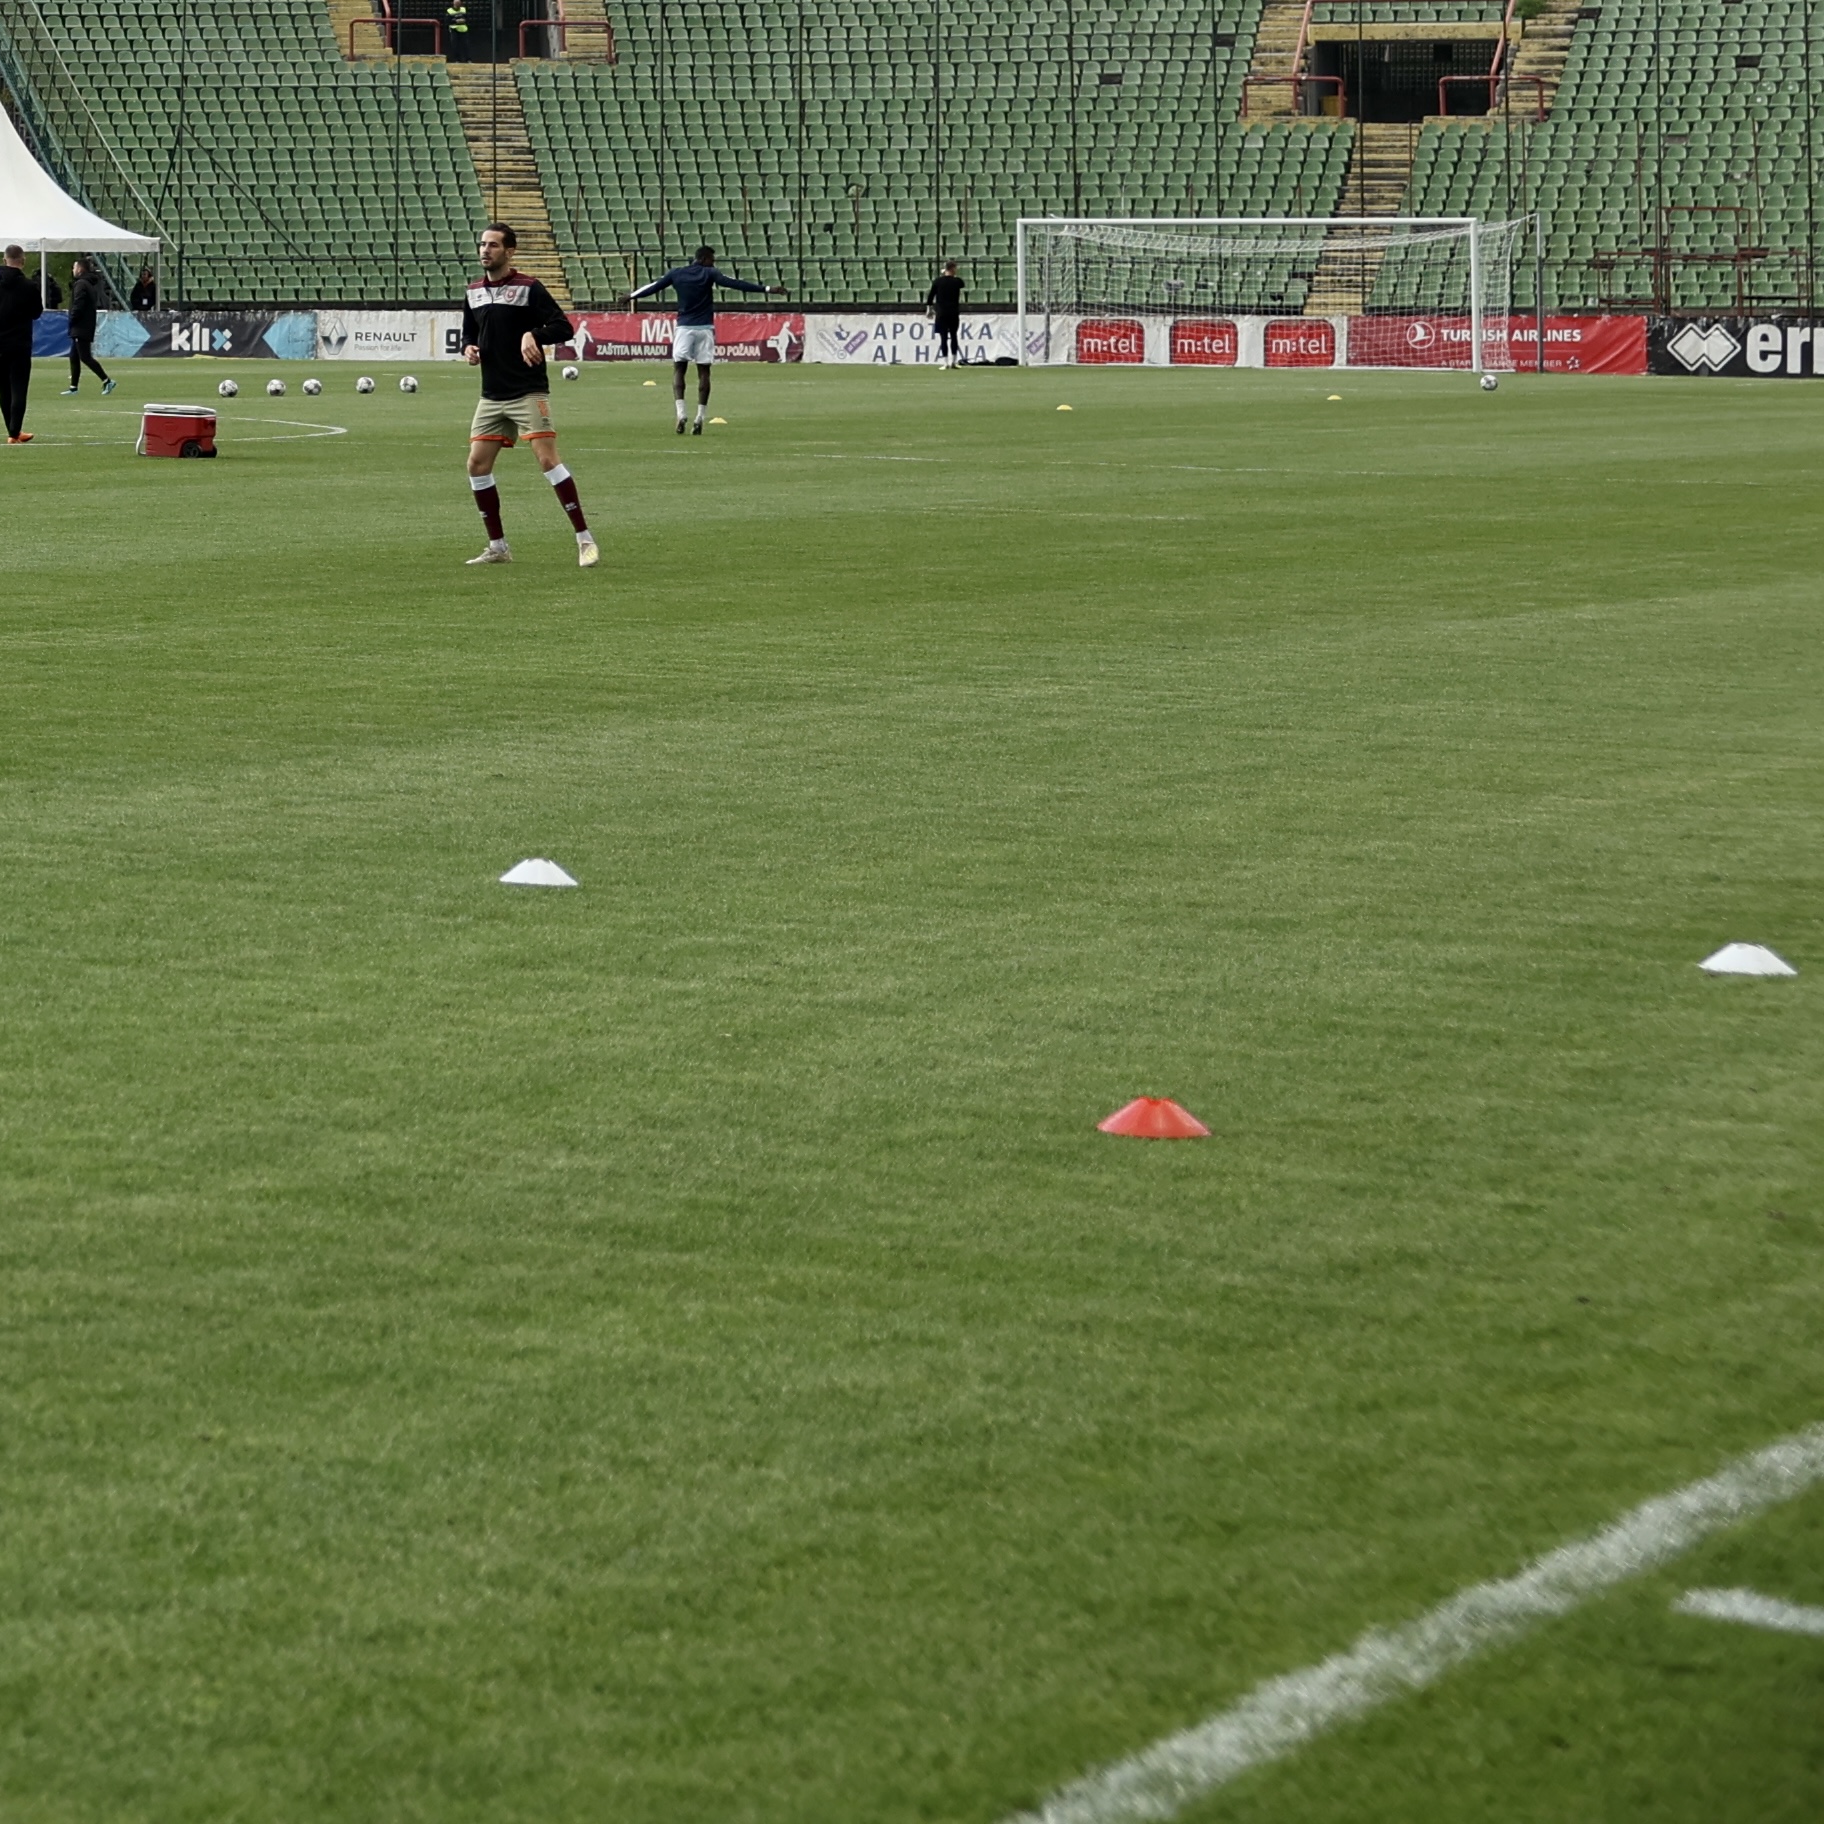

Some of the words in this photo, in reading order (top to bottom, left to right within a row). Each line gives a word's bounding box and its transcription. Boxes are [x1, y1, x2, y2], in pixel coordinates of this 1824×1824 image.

[171, 322, 233, 352] klix
[354, 331, 417, 343] RENAULT
[641, 319, 677, 343] MA
[873, 322, 993, 341] APOTKA
[1441, 329, 1508, 342] TURISH
[596, 342, 630, 356] ZAŠTITA
[630, 344, 643, 356] NA
[643, 344, 668, 356] RADU
[713, 345, 726, 356] OD
[727, 343, 761, 356] POŽARA
[1083, 334, 1137, 353] m:tel
[1177, 334, 1231, 354] m:tel
[1271, 335, 1327, 354] m:tel
[873, 345, 901, 363] AL
